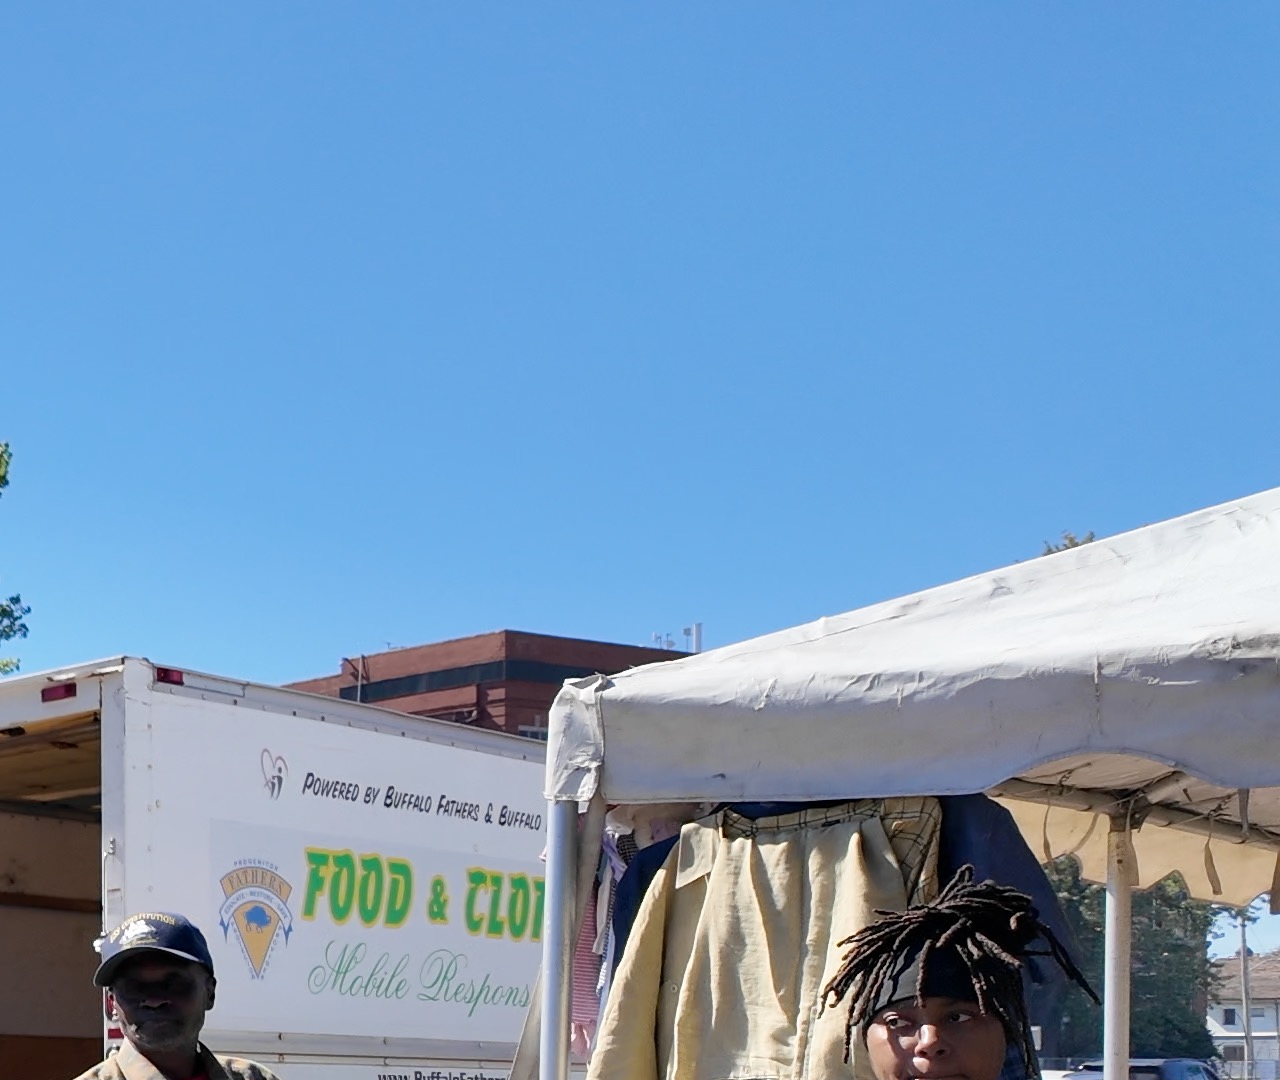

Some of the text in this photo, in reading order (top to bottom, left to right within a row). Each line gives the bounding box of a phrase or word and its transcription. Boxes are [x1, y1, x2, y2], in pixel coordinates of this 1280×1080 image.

[302, 772, 541, 831] POWERED BY BUFFALO FATHERS & BUFFALO
[227, 869, 283, 897] FATHERS
[301, 846, 546, 943] FOOD & CLOT
[307, 940, 533, 1018] Mobile Respons
